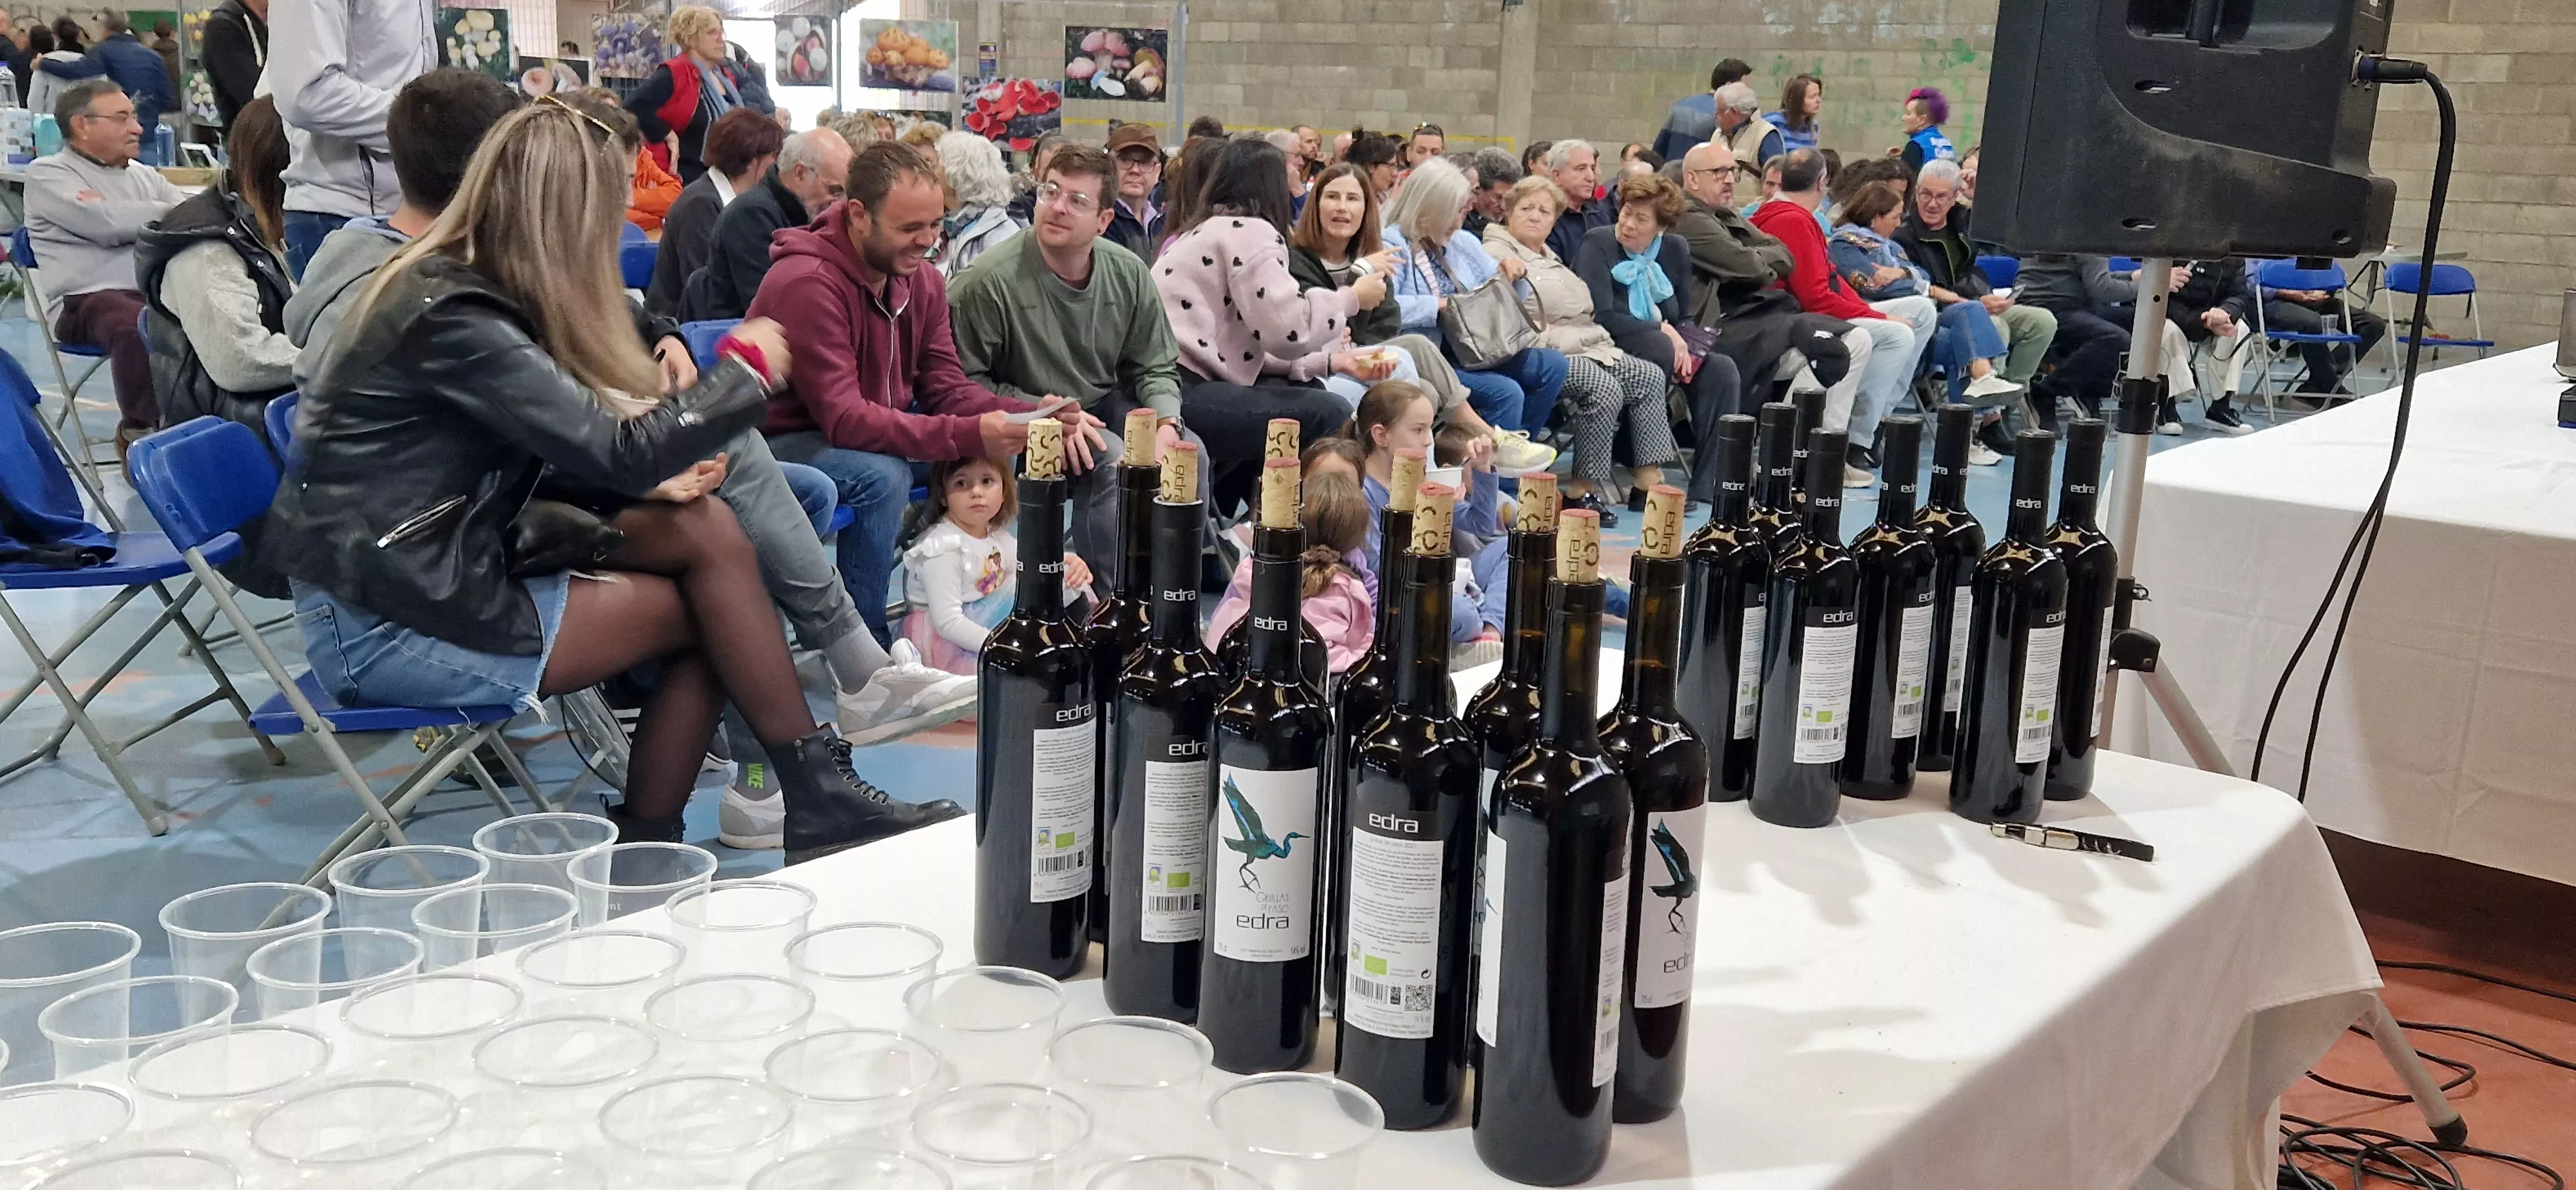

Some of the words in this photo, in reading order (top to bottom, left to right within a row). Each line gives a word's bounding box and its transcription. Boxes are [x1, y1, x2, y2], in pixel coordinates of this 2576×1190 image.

[1794, 448, 1810, 458] edr
[1932, 464, 1948, 475] dra
[2071, 484, 2096, 494] edra
[1815, 496, 1839, 507] edra
[2016, 498, 2042, 509] edra
[1660, 511, 1675, 554] edra
[1164, 589, 1196, 601] edra
[1255, 616, 1287, 630] edra
[1823, 610, 1853, 623] edra
[1056, 704, 1092, 722] edra
[747, 764, 763, 789] NIKE
[1368, 813, 1419, 833] edra
[1236, 913, 1289, 929] edra
